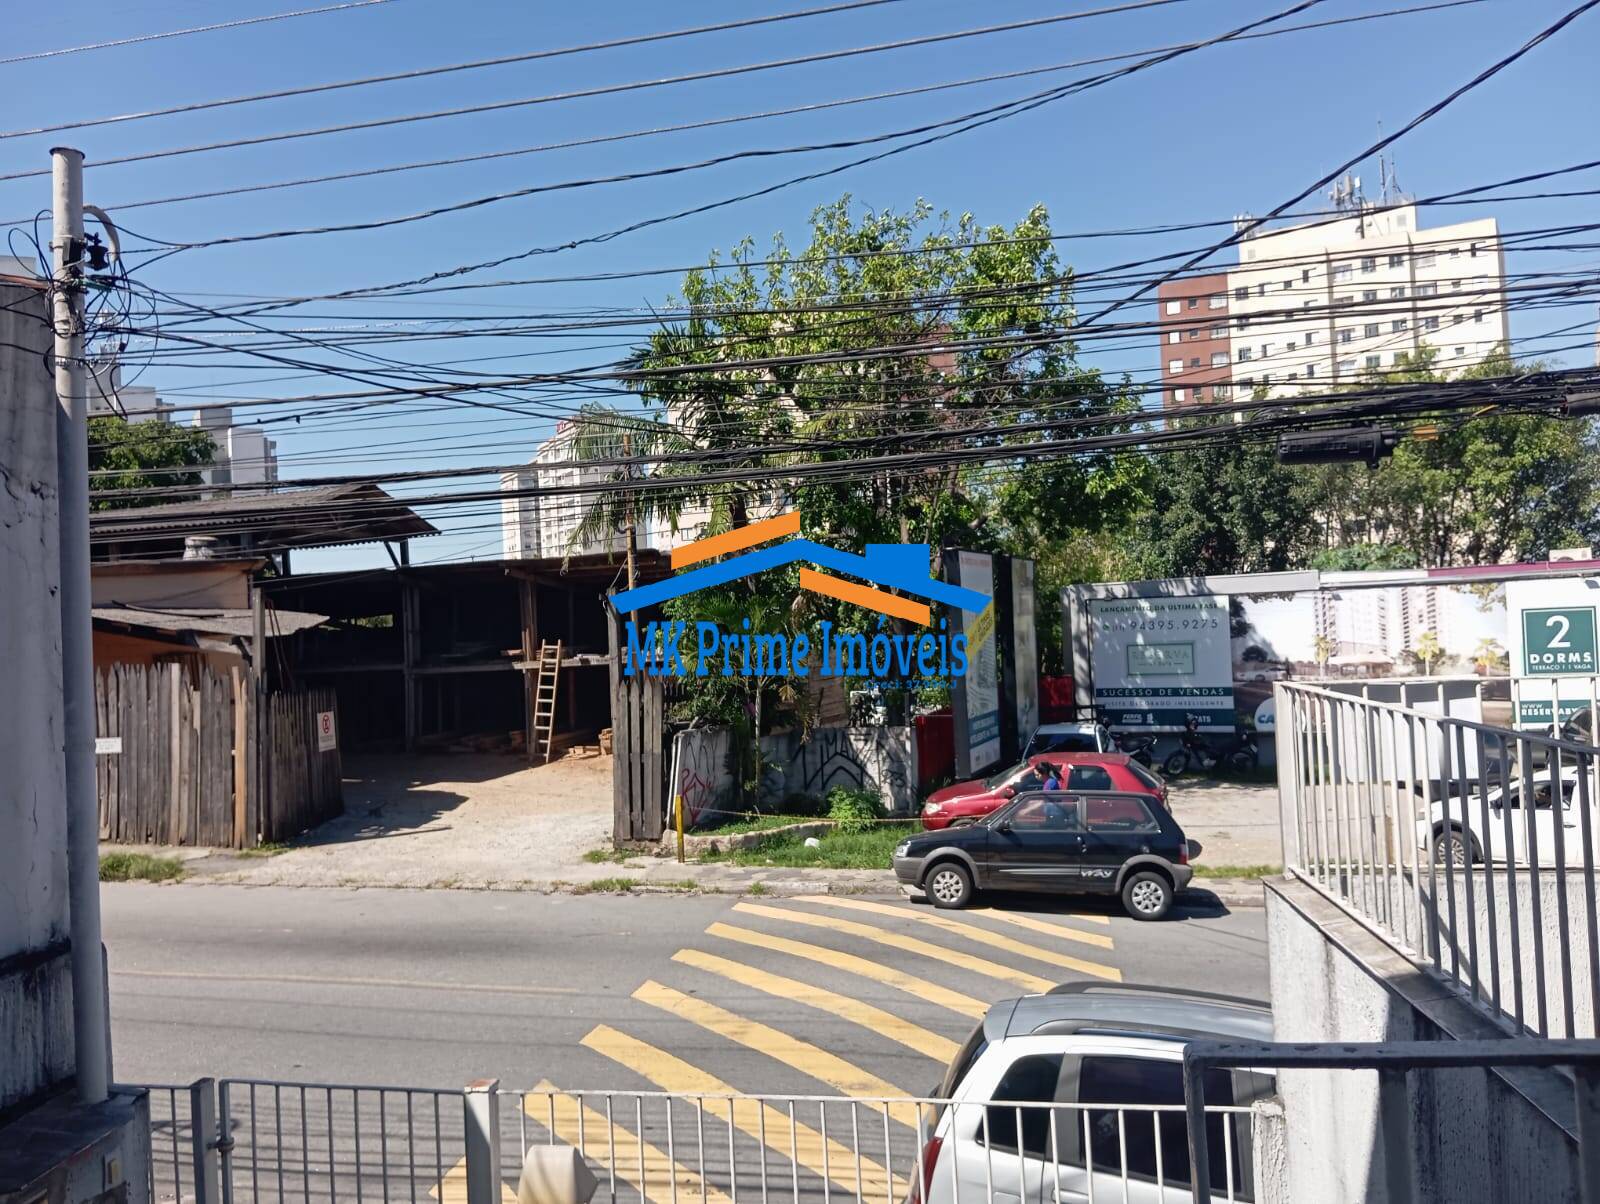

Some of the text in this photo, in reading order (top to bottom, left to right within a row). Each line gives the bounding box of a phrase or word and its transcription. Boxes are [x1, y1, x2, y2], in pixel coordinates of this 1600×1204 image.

[1130, 618, 1218, 631] 94395.9275
[1546, 615, 1571, 648] 2
[1102, 689, 1153, 697] SUCESSO
[1178, 688, 1225, 696] VENDAS
